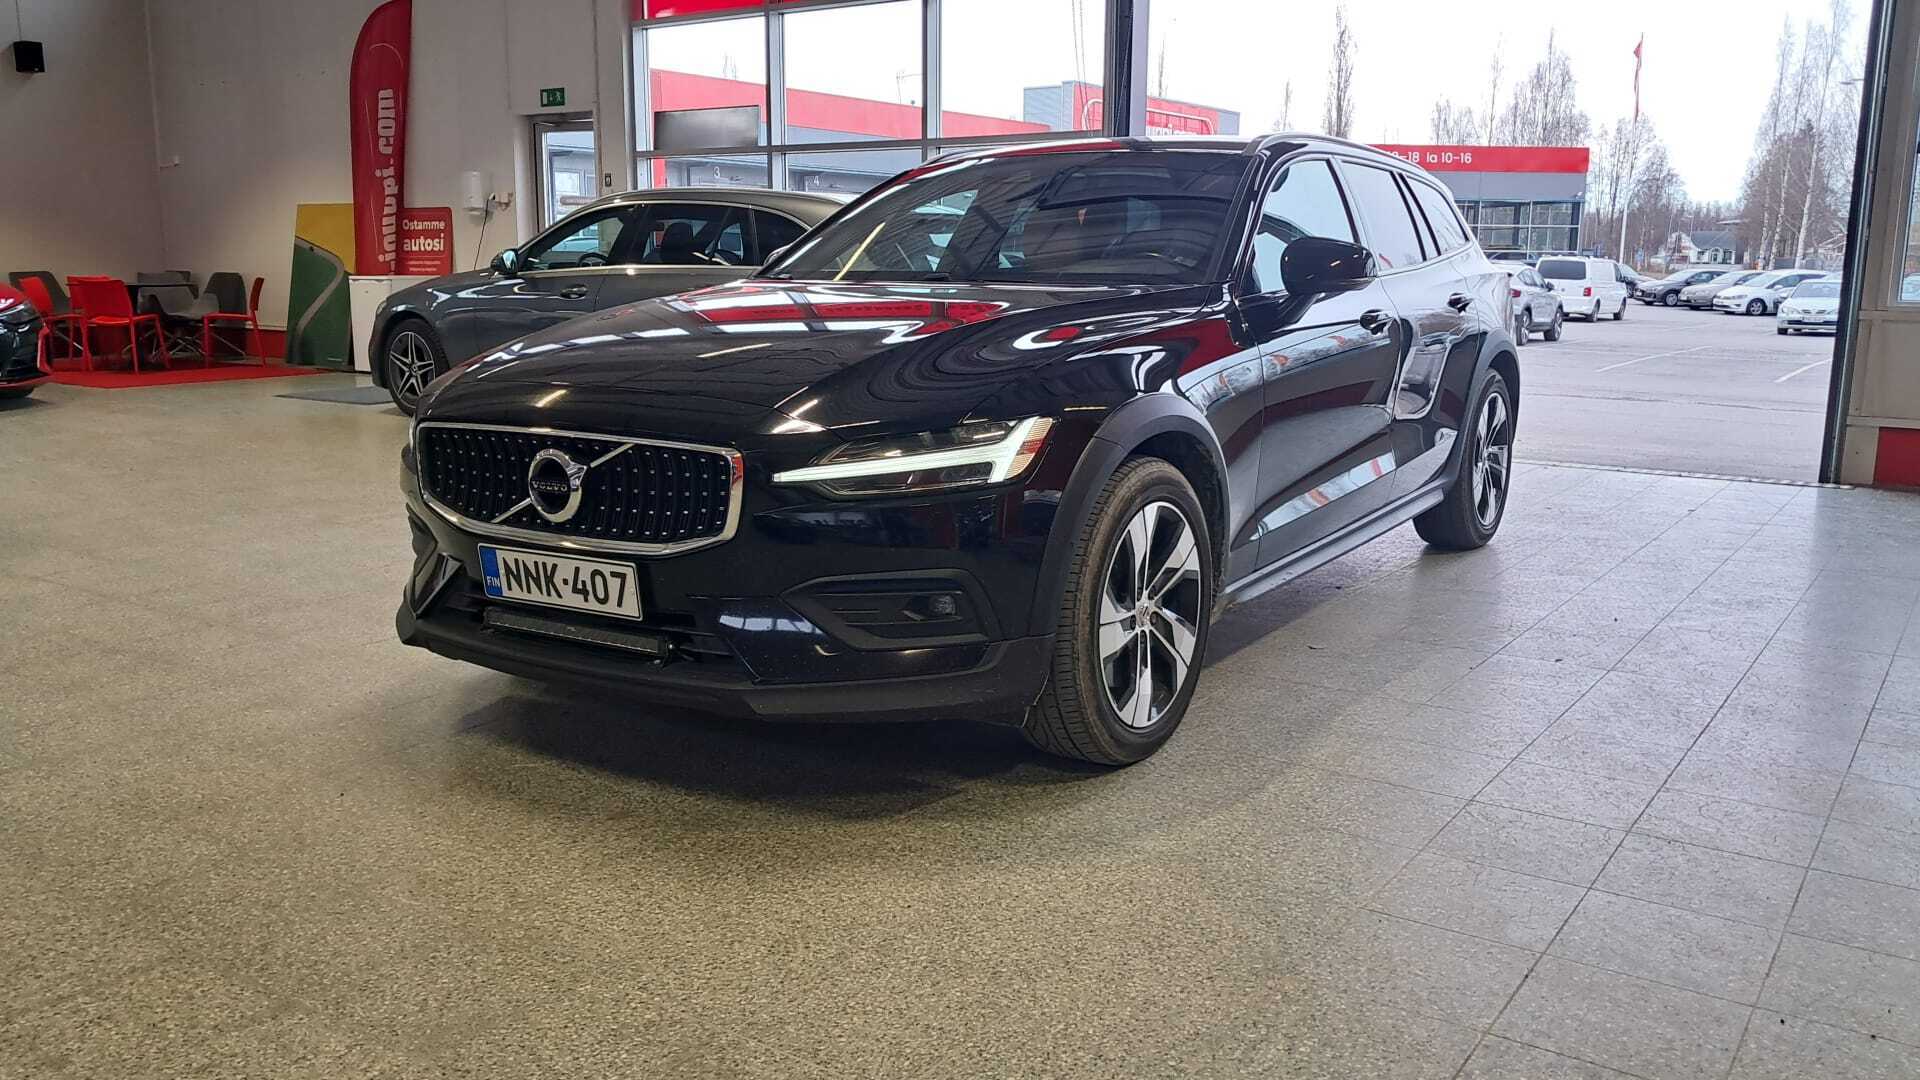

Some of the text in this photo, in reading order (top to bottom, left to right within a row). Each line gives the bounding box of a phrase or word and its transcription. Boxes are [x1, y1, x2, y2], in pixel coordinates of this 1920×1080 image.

[1441, 152, 1472, 164] 10-16
[713, 166, 721, 178] 3
[402, 219, 446, 230] Ostamme
[403, 232, 444, 252] autosi
[531, 480, 568, 492] VOLVO
[486, 575, 500, 588] FIN
[502, 556, 628, 609] NNK-407
